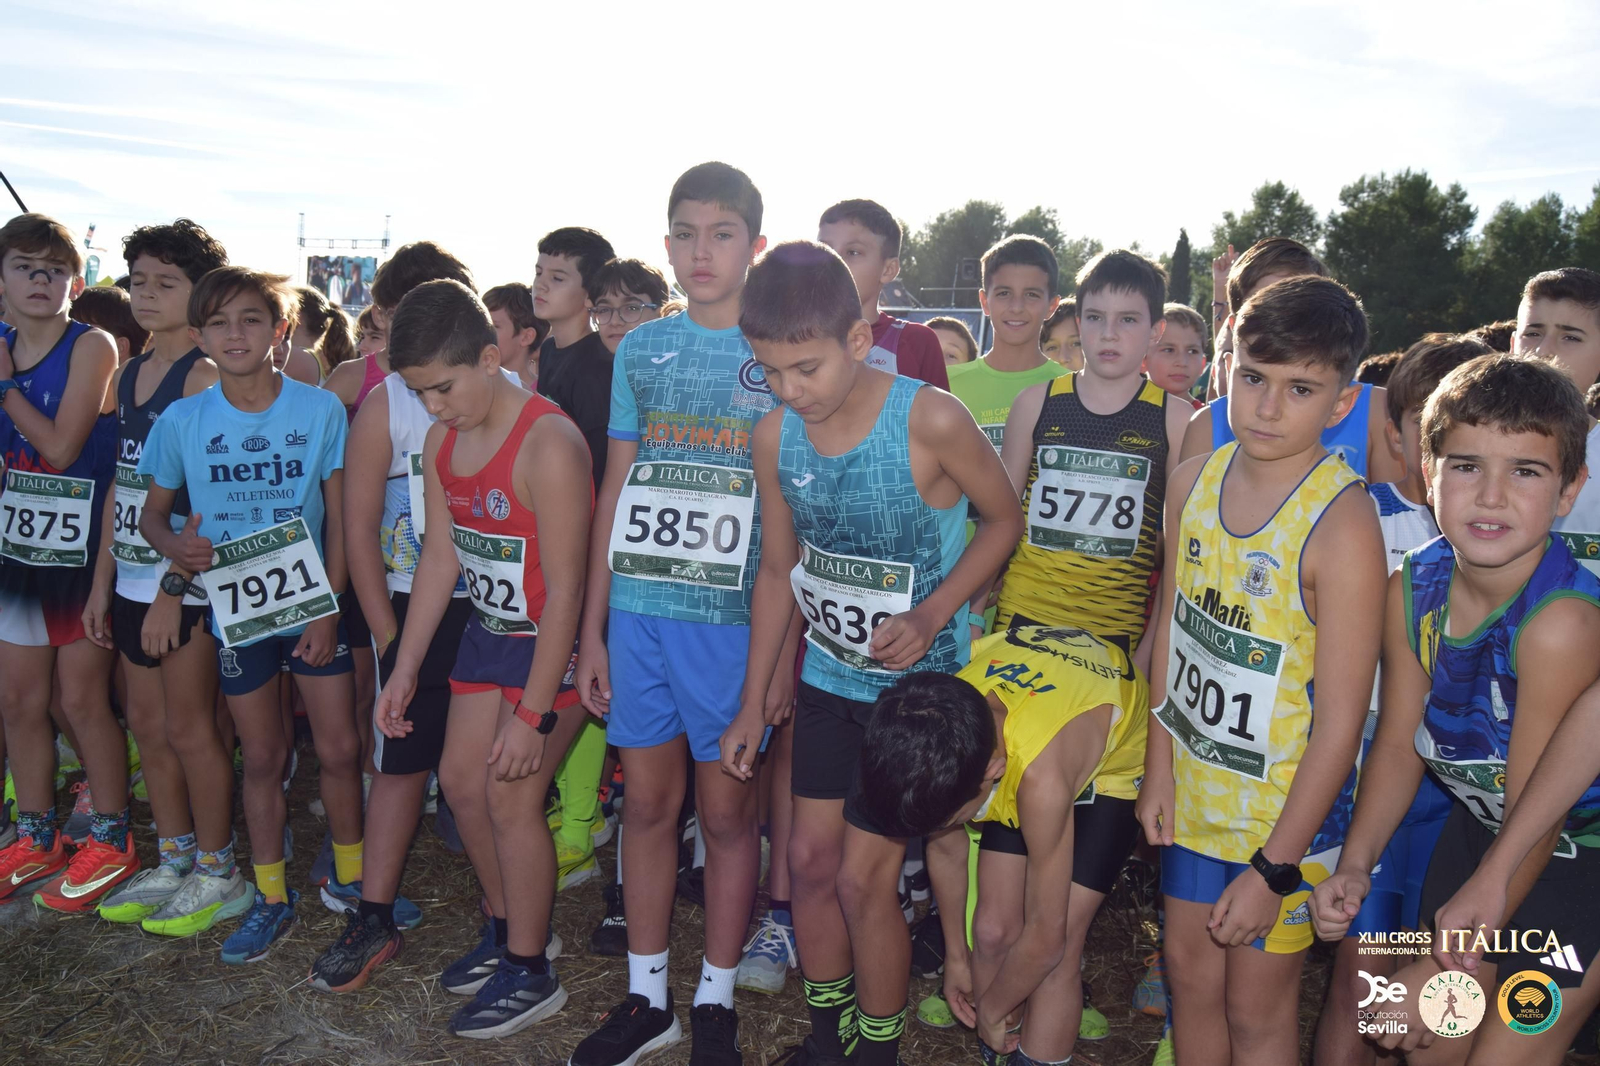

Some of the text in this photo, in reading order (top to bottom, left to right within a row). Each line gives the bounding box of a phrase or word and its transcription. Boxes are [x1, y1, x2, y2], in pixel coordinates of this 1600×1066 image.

[243, 439, 270, 452] TROPS
[642, 422, 749, 450] JOVIMAR
[646, 438, 697, 451] Equipamos
[710, 443, 721, 452] tu
[725, 446, 747, 457] club
[209, 453, 304, 486] nerja
[1064, 452, 1120, 470] ITÁLICA
[17, 475, 64, 491] ITÁLICA
[659, 465, 720, 485] ITÁLICA
[227, 489, 295, 502] ATLETISMO
[1038, 485, 1136, 529] 5778
[4, 505, 81, 543] 7875
[625, 504, 741, 554] 5850
[224, 533, 279, 558] ITÁLICA
[456, 531, 494, 553] ITÁLICA
[814, 555, 873, 580] ITÁLICA
[217, 559, 320, 615] 7921
[1202, 587, 1252, 633] Mafia
[1190, 612, 1236, 654] ITÁLICA
[1173, 647, 1255, 742] 7901
